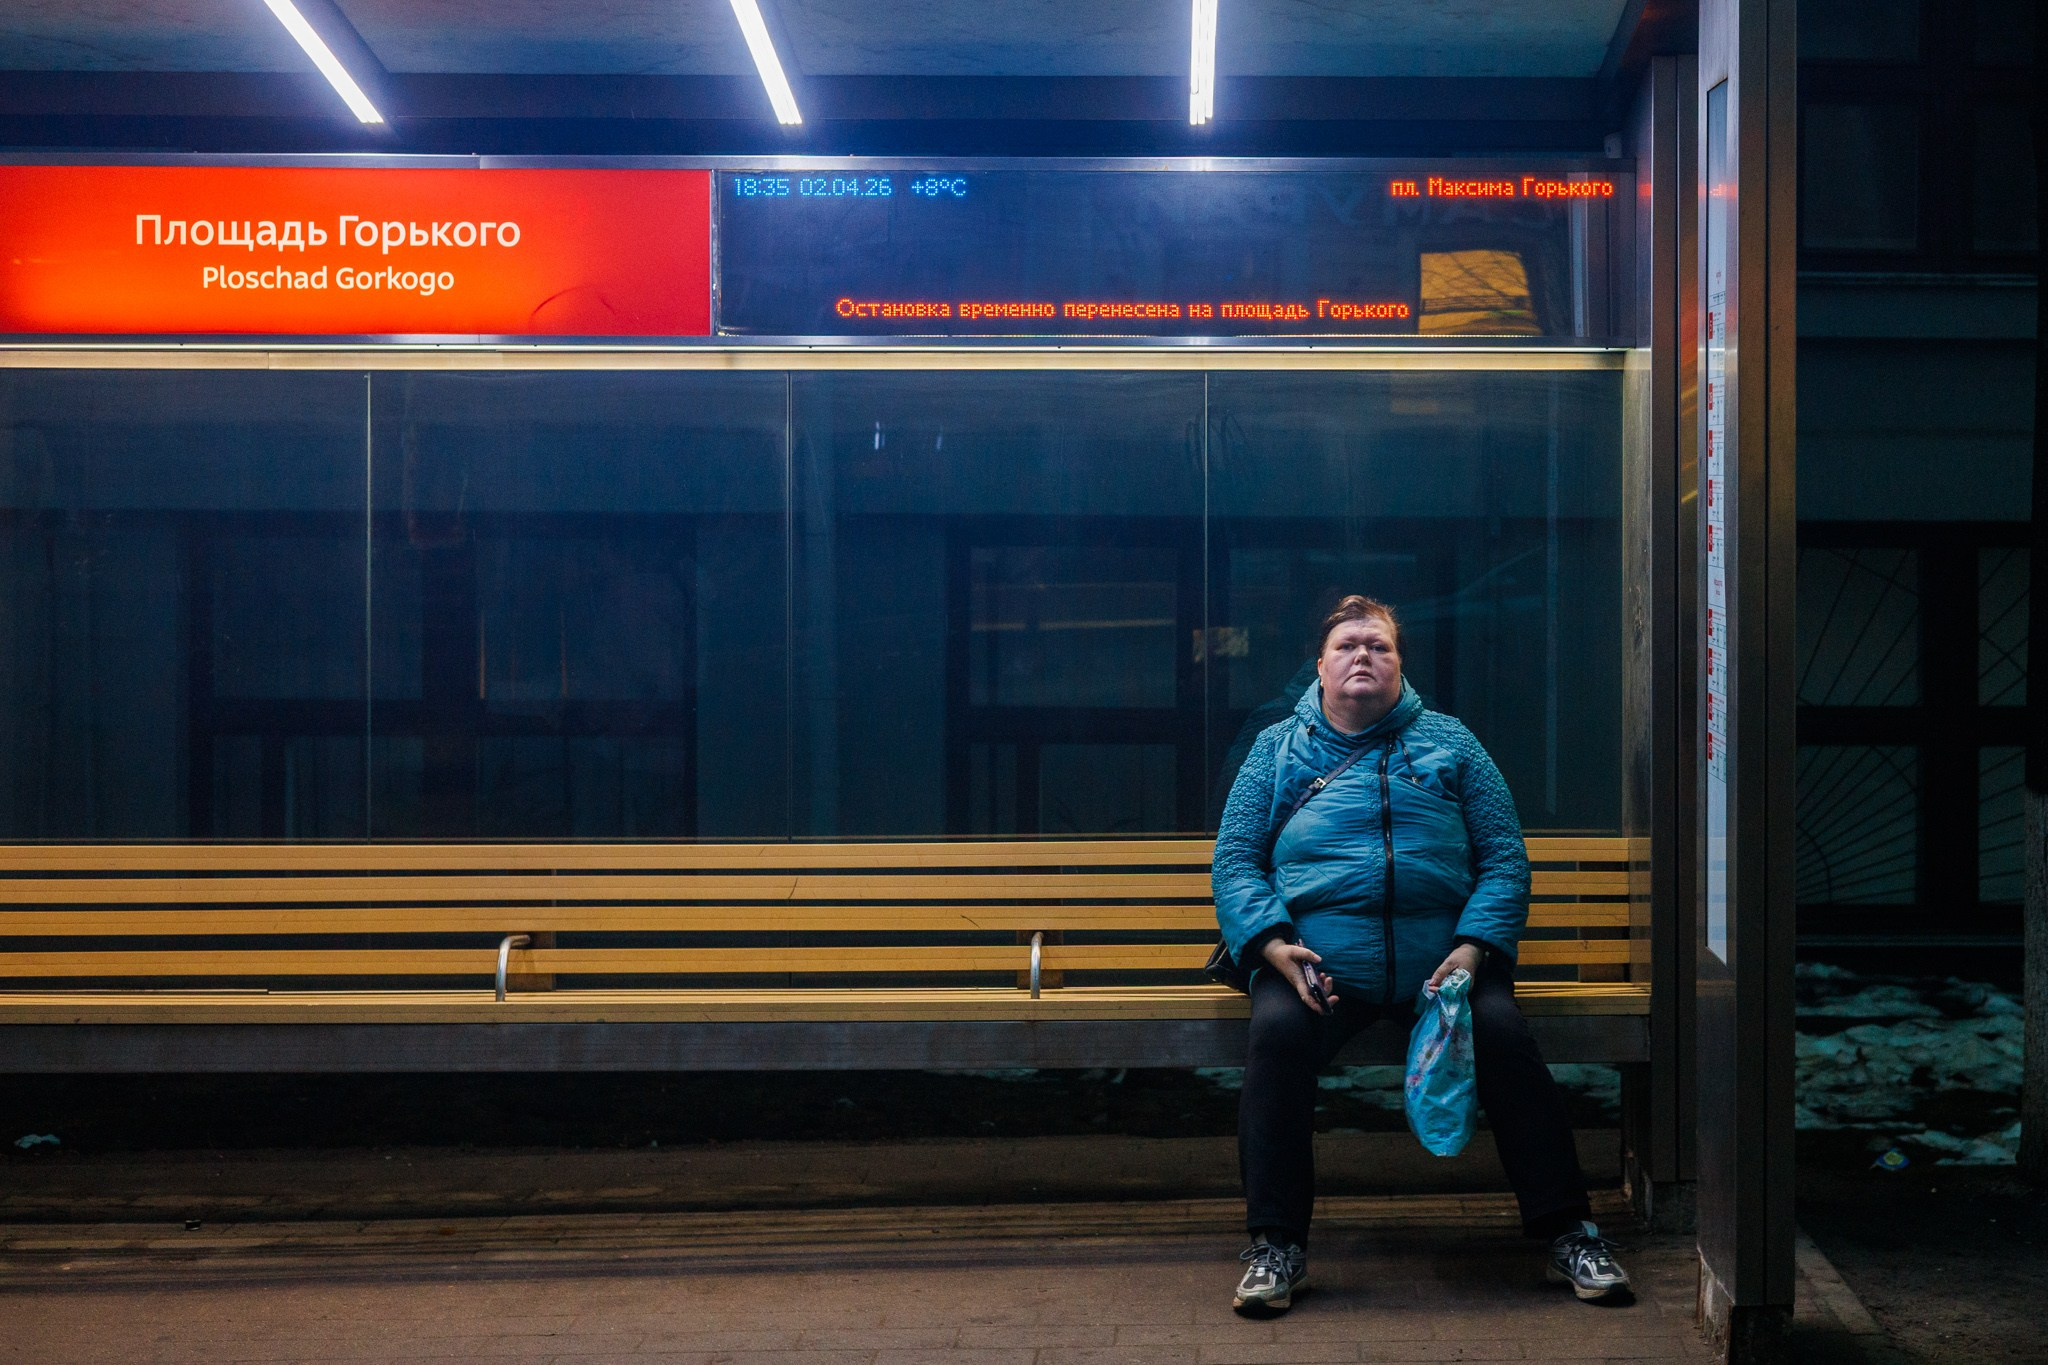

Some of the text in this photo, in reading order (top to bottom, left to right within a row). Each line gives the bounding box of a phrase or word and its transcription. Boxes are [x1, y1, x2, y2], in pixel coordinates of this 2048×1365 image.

[734, 178, 790, 197] 18:35
[799, 178, 892, 197] 02.04.26
[1391, 177, 1614, 199] пл. Максима Горького
[135, 214, 521, 254] Площадь Горького
[203, 265, 455, 296] Ploschad Gorkogo
[836, 298, 1410, 320] Остановка временно перенесена на площадь Горького
